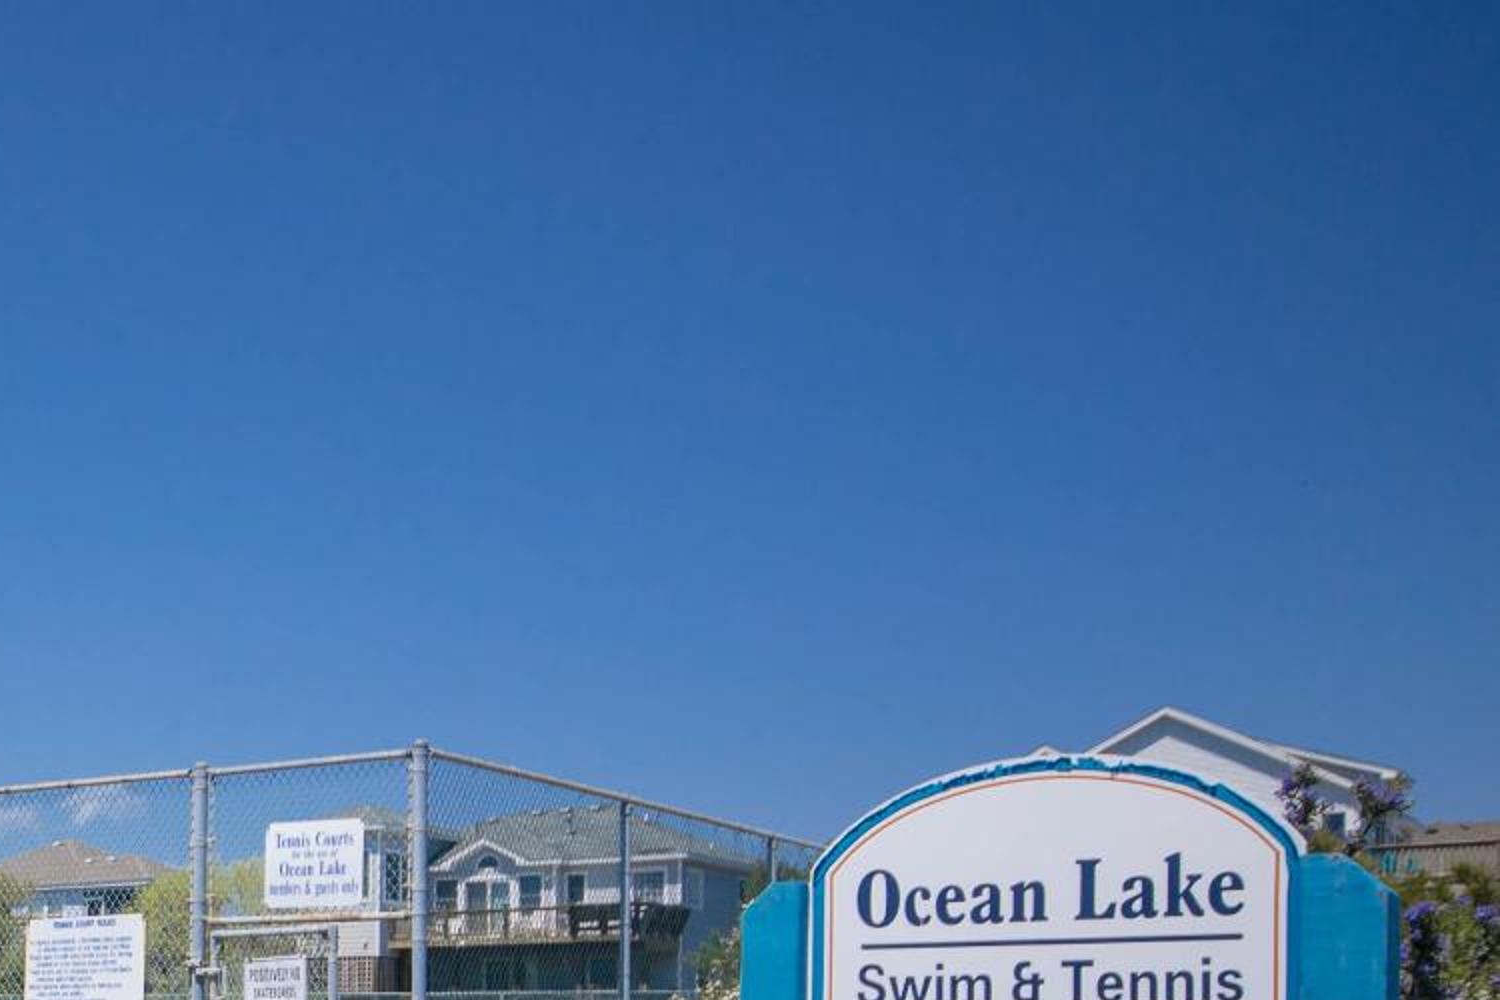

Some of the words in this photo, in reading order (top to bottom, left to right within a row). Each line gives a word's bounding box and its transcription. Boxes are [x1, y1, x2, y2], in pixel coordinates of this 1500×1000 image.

[277, 833, 311, 848] Tennis
[315, 832, 355, 847] Courts
[280, 863, 315, 877] Ocean
[319, 860, 347, 875] Lake
[857, 869, 1049, 929] Ocean
[1074, 852, 1246, 921] Lake
